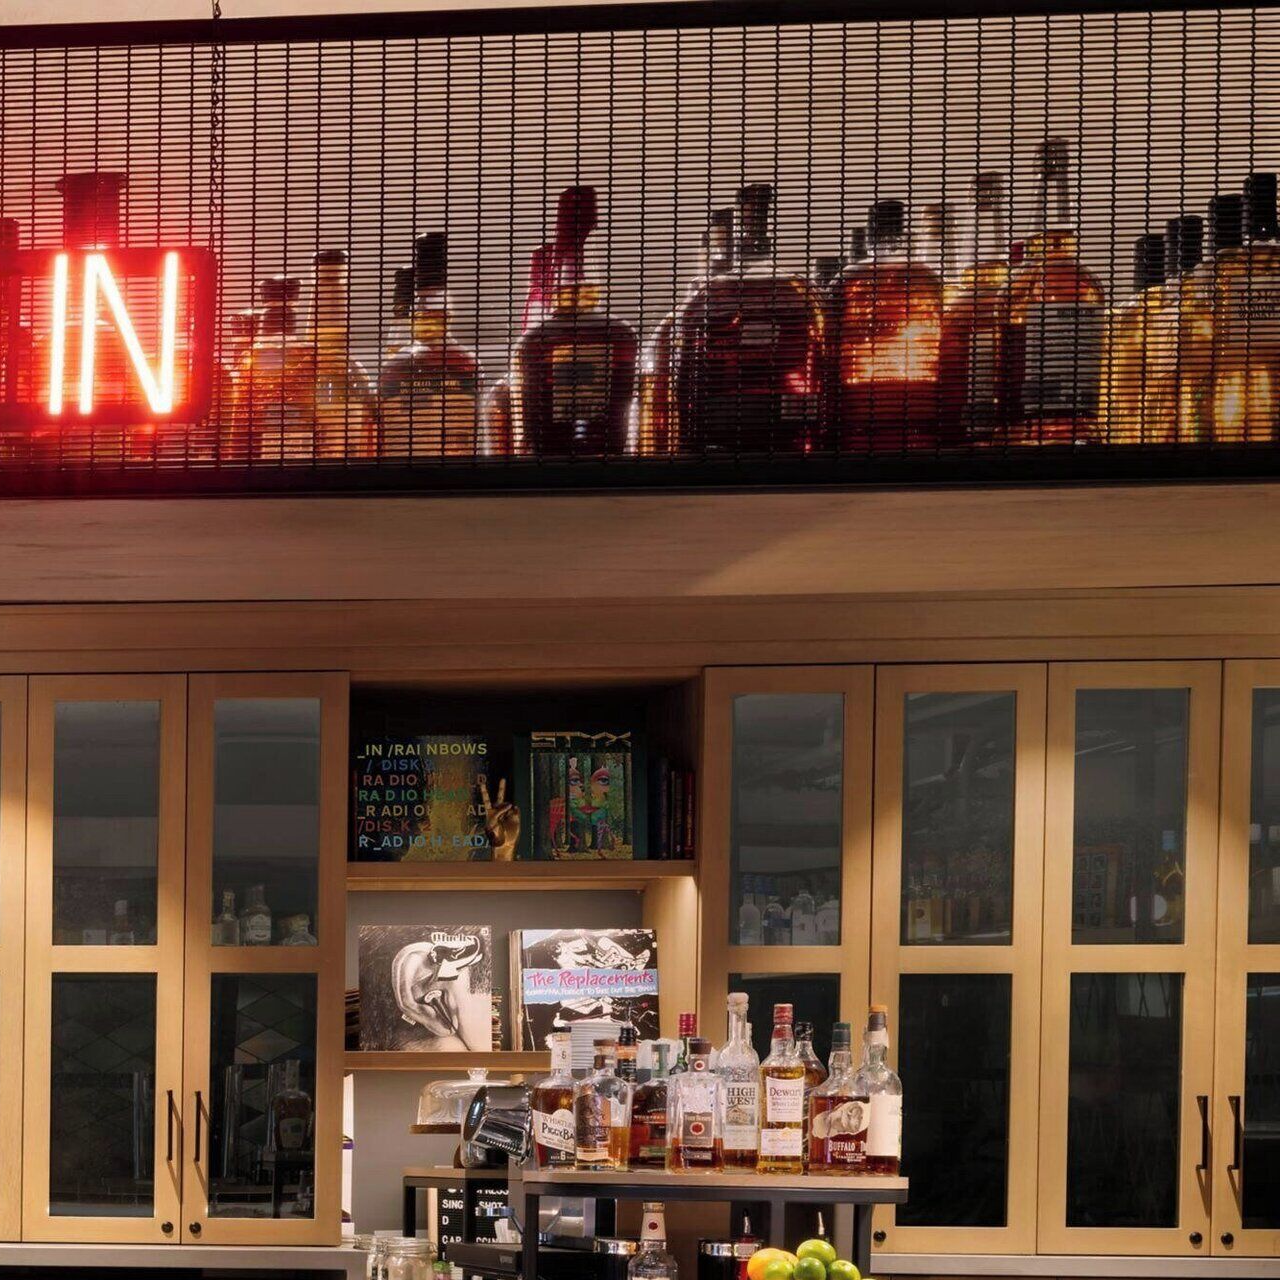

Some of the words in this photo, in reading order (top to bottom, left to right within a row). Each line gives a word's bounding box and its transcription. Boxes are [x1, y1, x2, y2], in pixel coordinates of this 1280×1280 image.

[48, 252, 179, 417] IN
[531, 732, 632, 748] STYX
[426, 743, 488, 756] NBOWS
[528, 972, 553, 987] The
[558, 969, 654, 988] Replacements
[727, 1087, 756, 1097] HIGH
[727, 1097, 756, 1106] WEST
[542, 1122, 575, 1141] PIGGYBA
[828, 1140, 856, 1151] BUFFALO
[442, 1199, 464, 1210] SING
